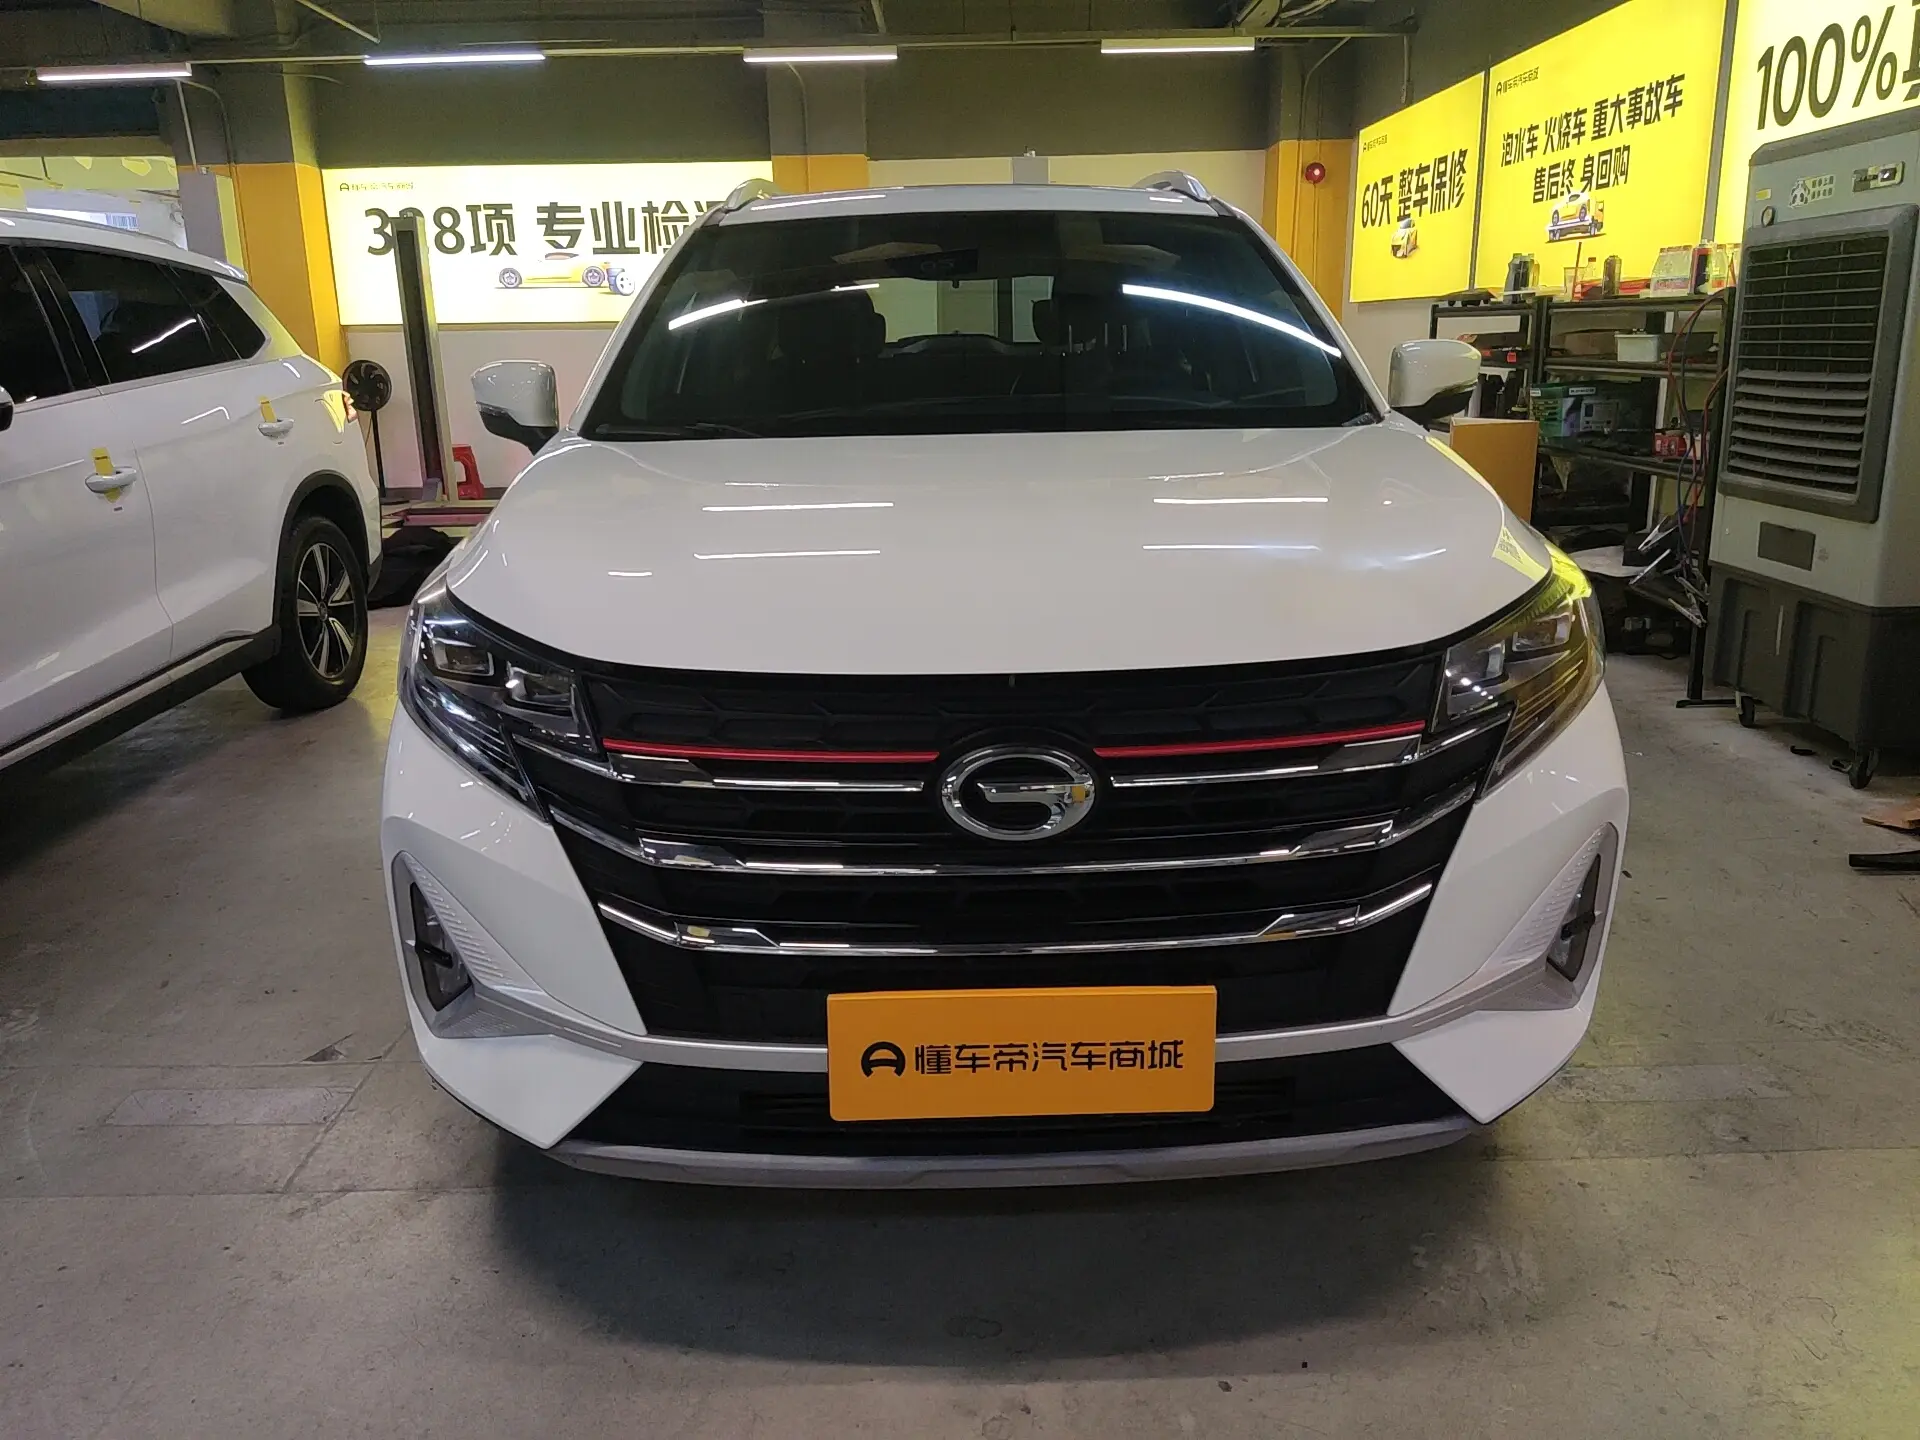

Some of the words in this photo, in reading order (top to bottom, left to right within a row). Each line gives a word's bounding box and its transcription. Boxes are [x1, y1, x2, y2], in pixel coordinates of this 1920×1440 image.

[1501, 124, 1540, 167] 泡水车
[1543, 107, 1587, 155] 火烧车
[1591, 73, 1685, 142] 重大事故车
[1361, 175, 1393, 229] 60天
[1396, 148, 1468, 223] 整车保修
[365, 203, 518, 256] 38项
[536, 201, 726, 255] 专业检
[914, 1039, 1184, 1075] 懂车帝汽车商城
